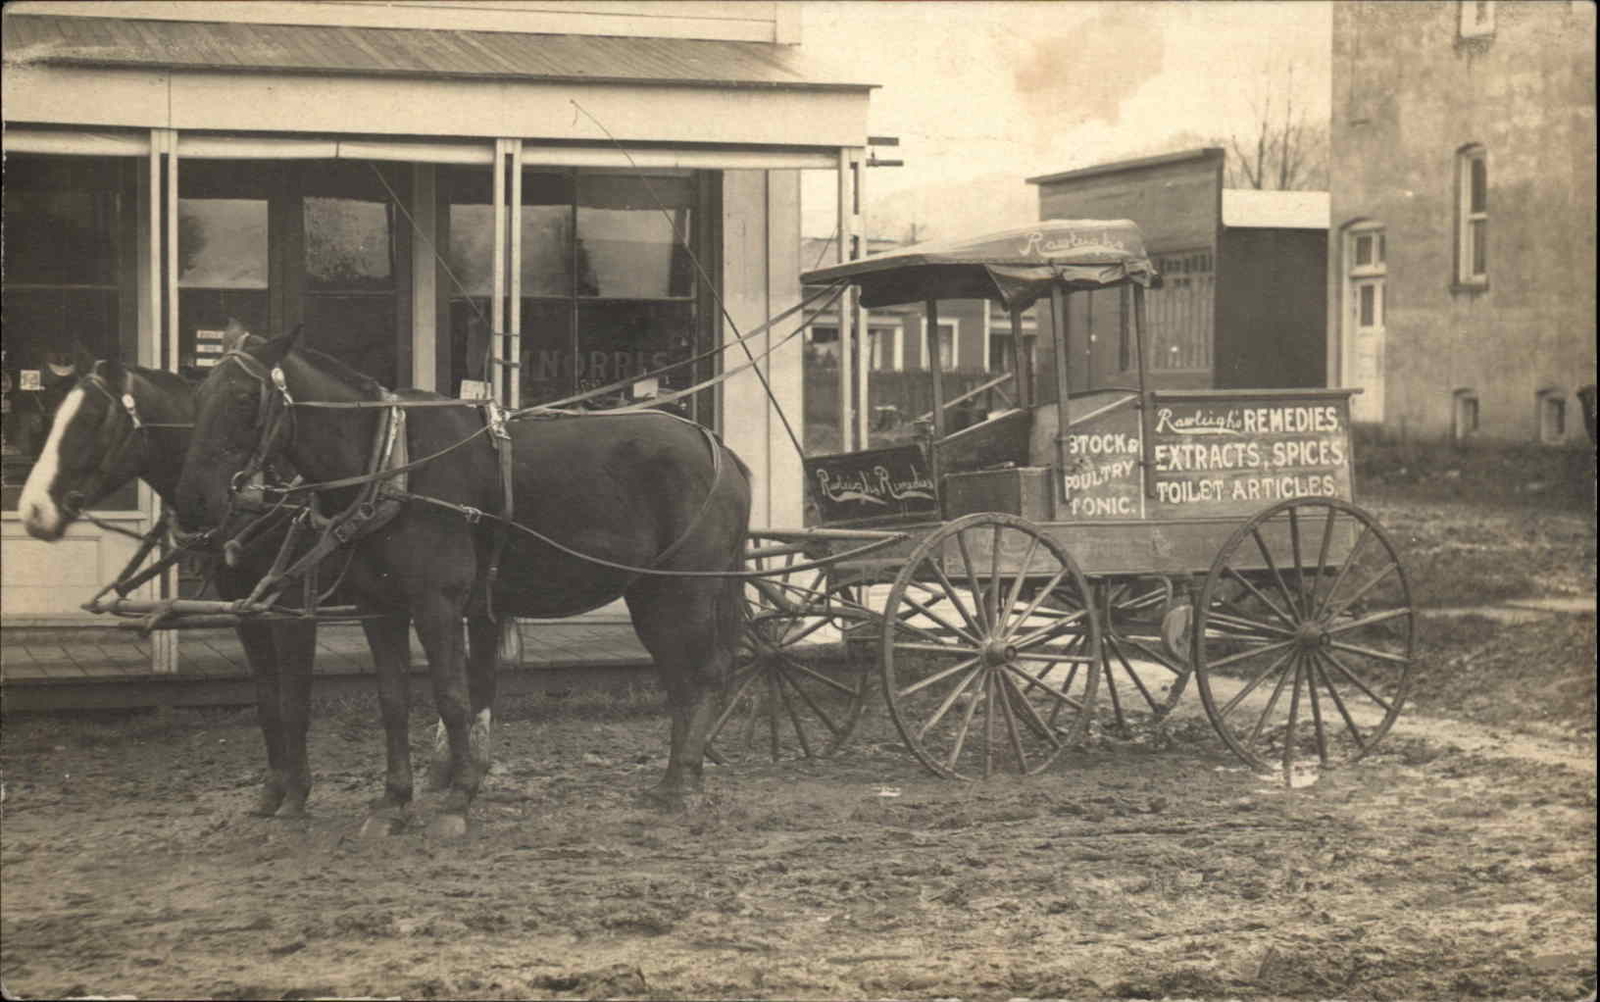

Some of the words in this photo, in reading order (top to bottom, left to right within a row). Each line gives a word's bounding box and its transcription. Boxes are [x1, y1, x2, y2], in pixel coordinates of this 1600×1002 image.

[1156, 408, 1242, 435] Rawleigh's
[1064, 460, 1135, 500] POULTRY
[1156, 480, 1224, 503] TOILET
[1069, 497, 1136, 516] TONIC.
